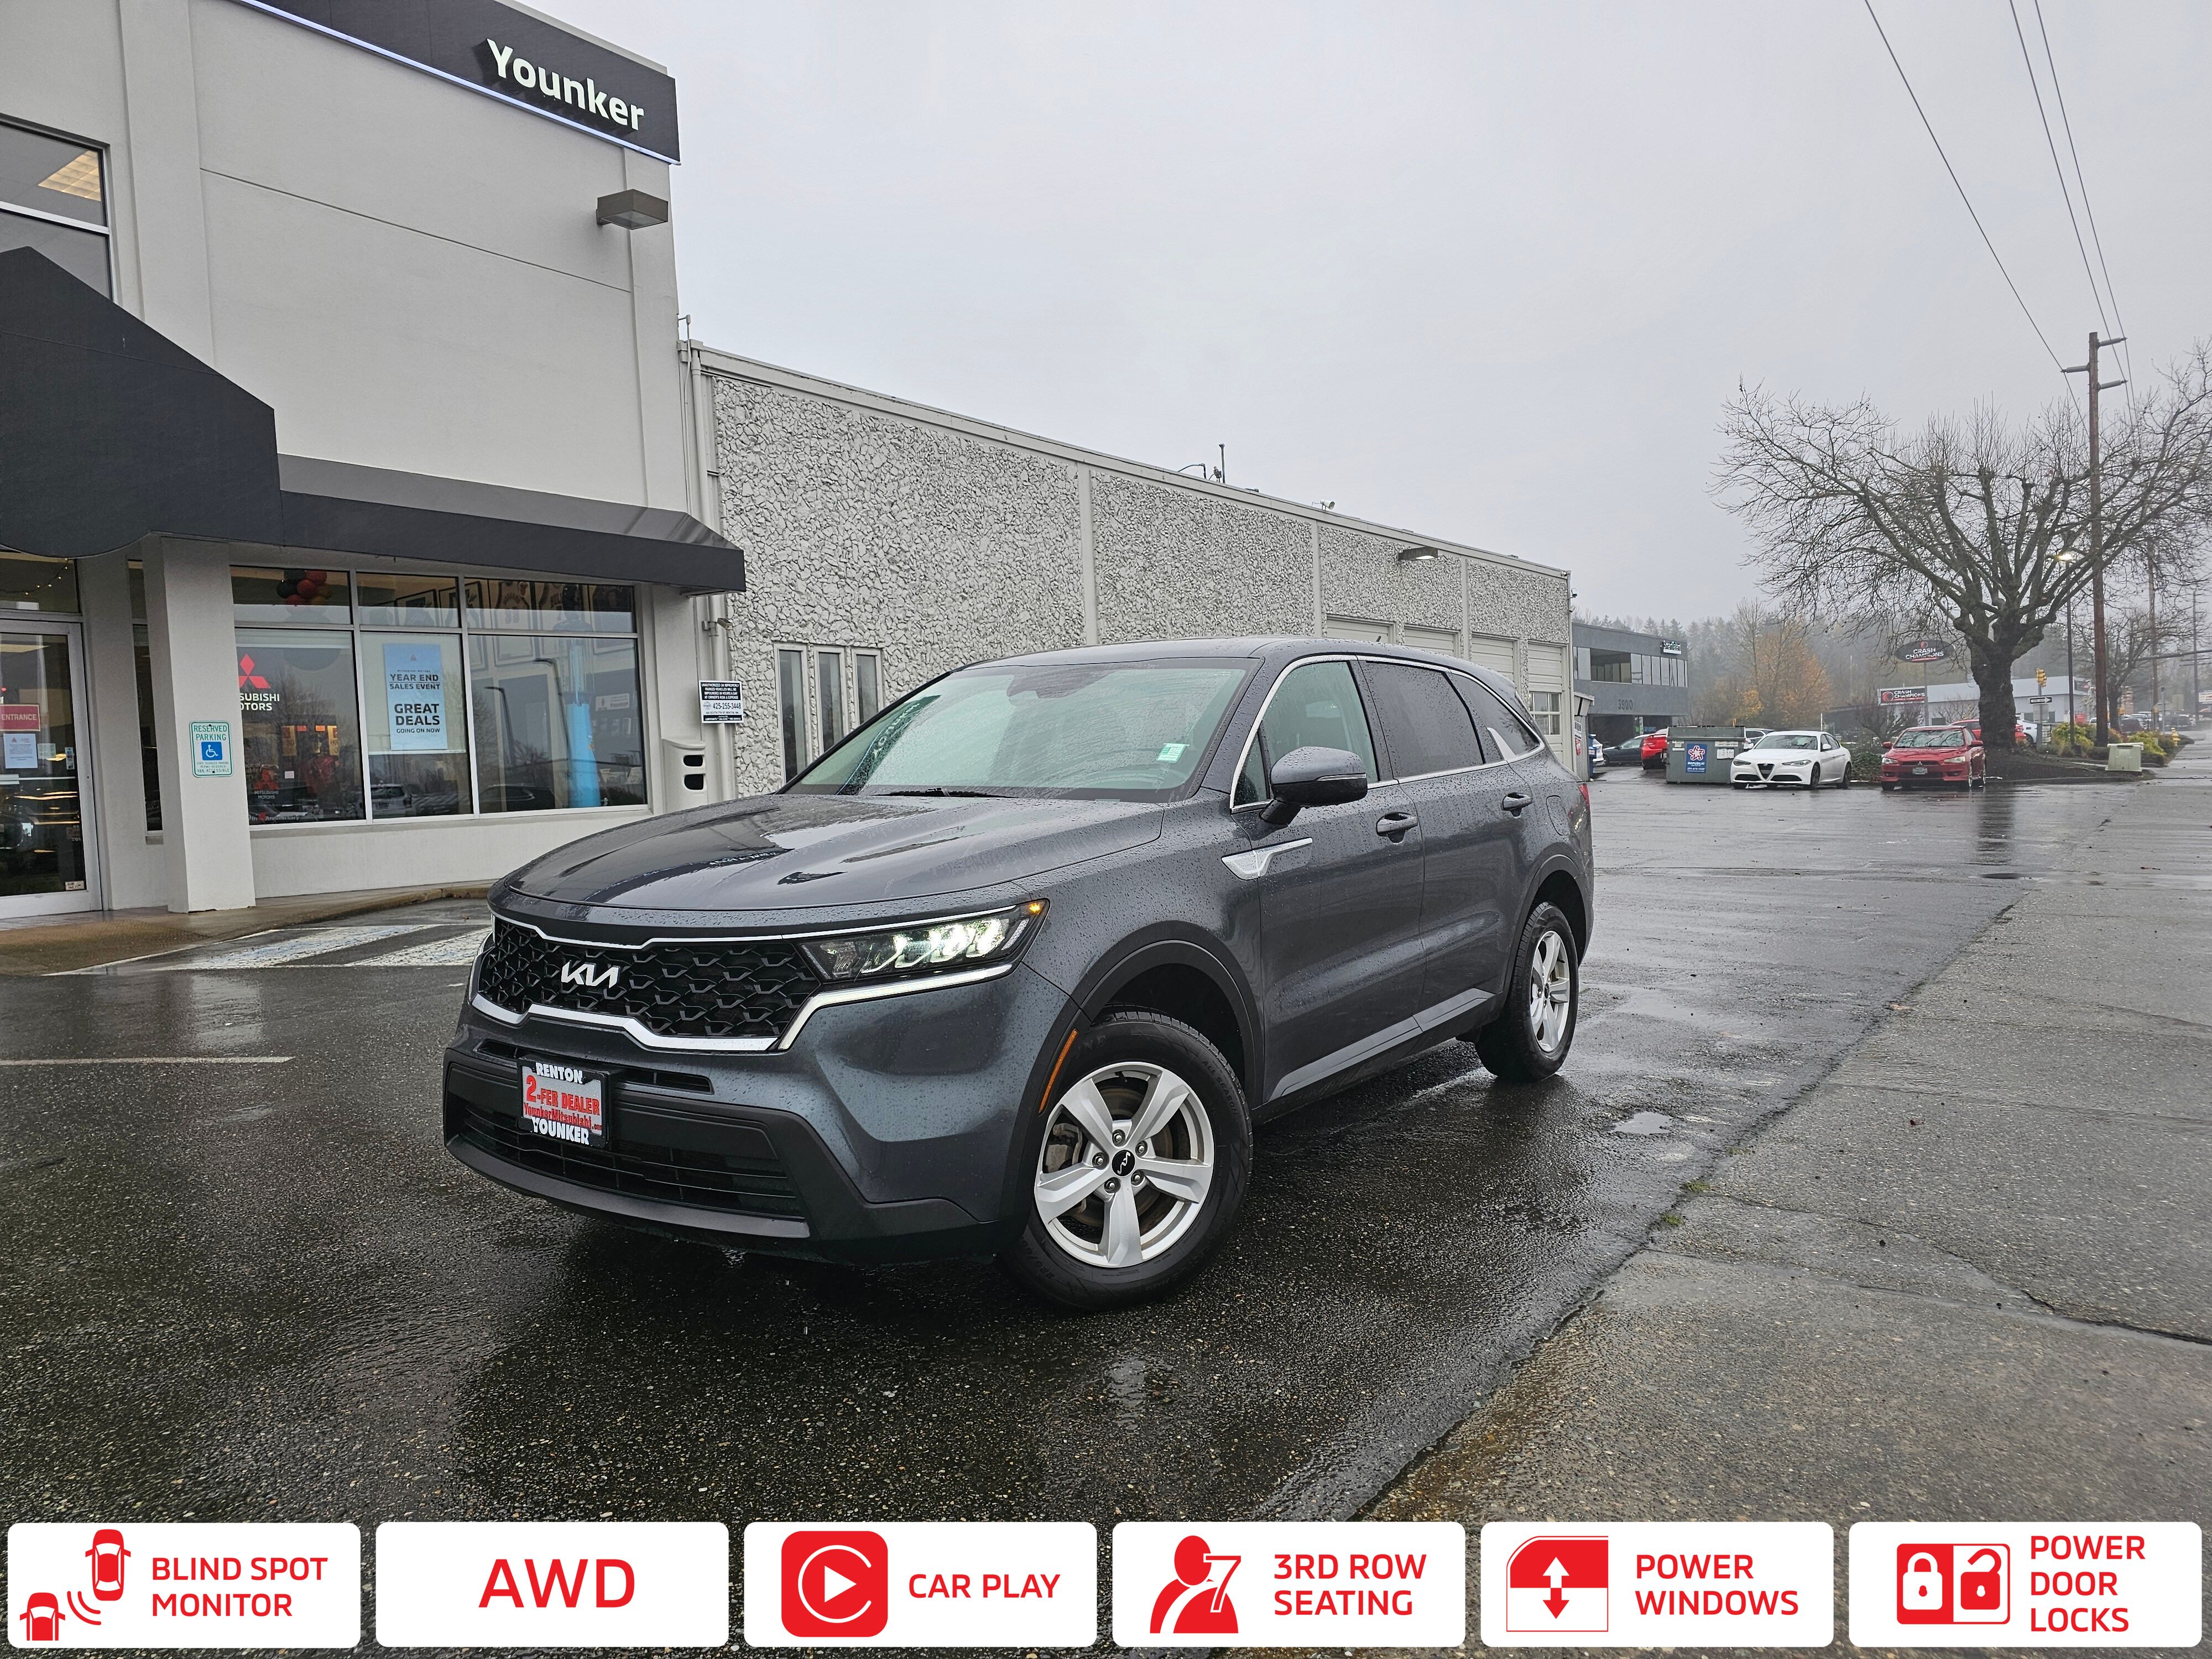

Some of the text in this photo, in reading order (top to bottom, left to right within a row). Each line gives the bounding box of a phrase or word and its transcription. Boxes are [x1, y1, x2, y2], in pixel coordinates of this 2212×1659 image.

[487, 38, 644, 131] Younker
[394, 703, 440, 714] GREAT
[396, 715, 440, 726] DEALS
[561, 961, 619, 989] KIA
[535, 1062, 583, 1084] RENTON
[526, 1075, 600, 1115] 2-FER DEALER
[531, 1117, 589, 1145] YOUNKER
